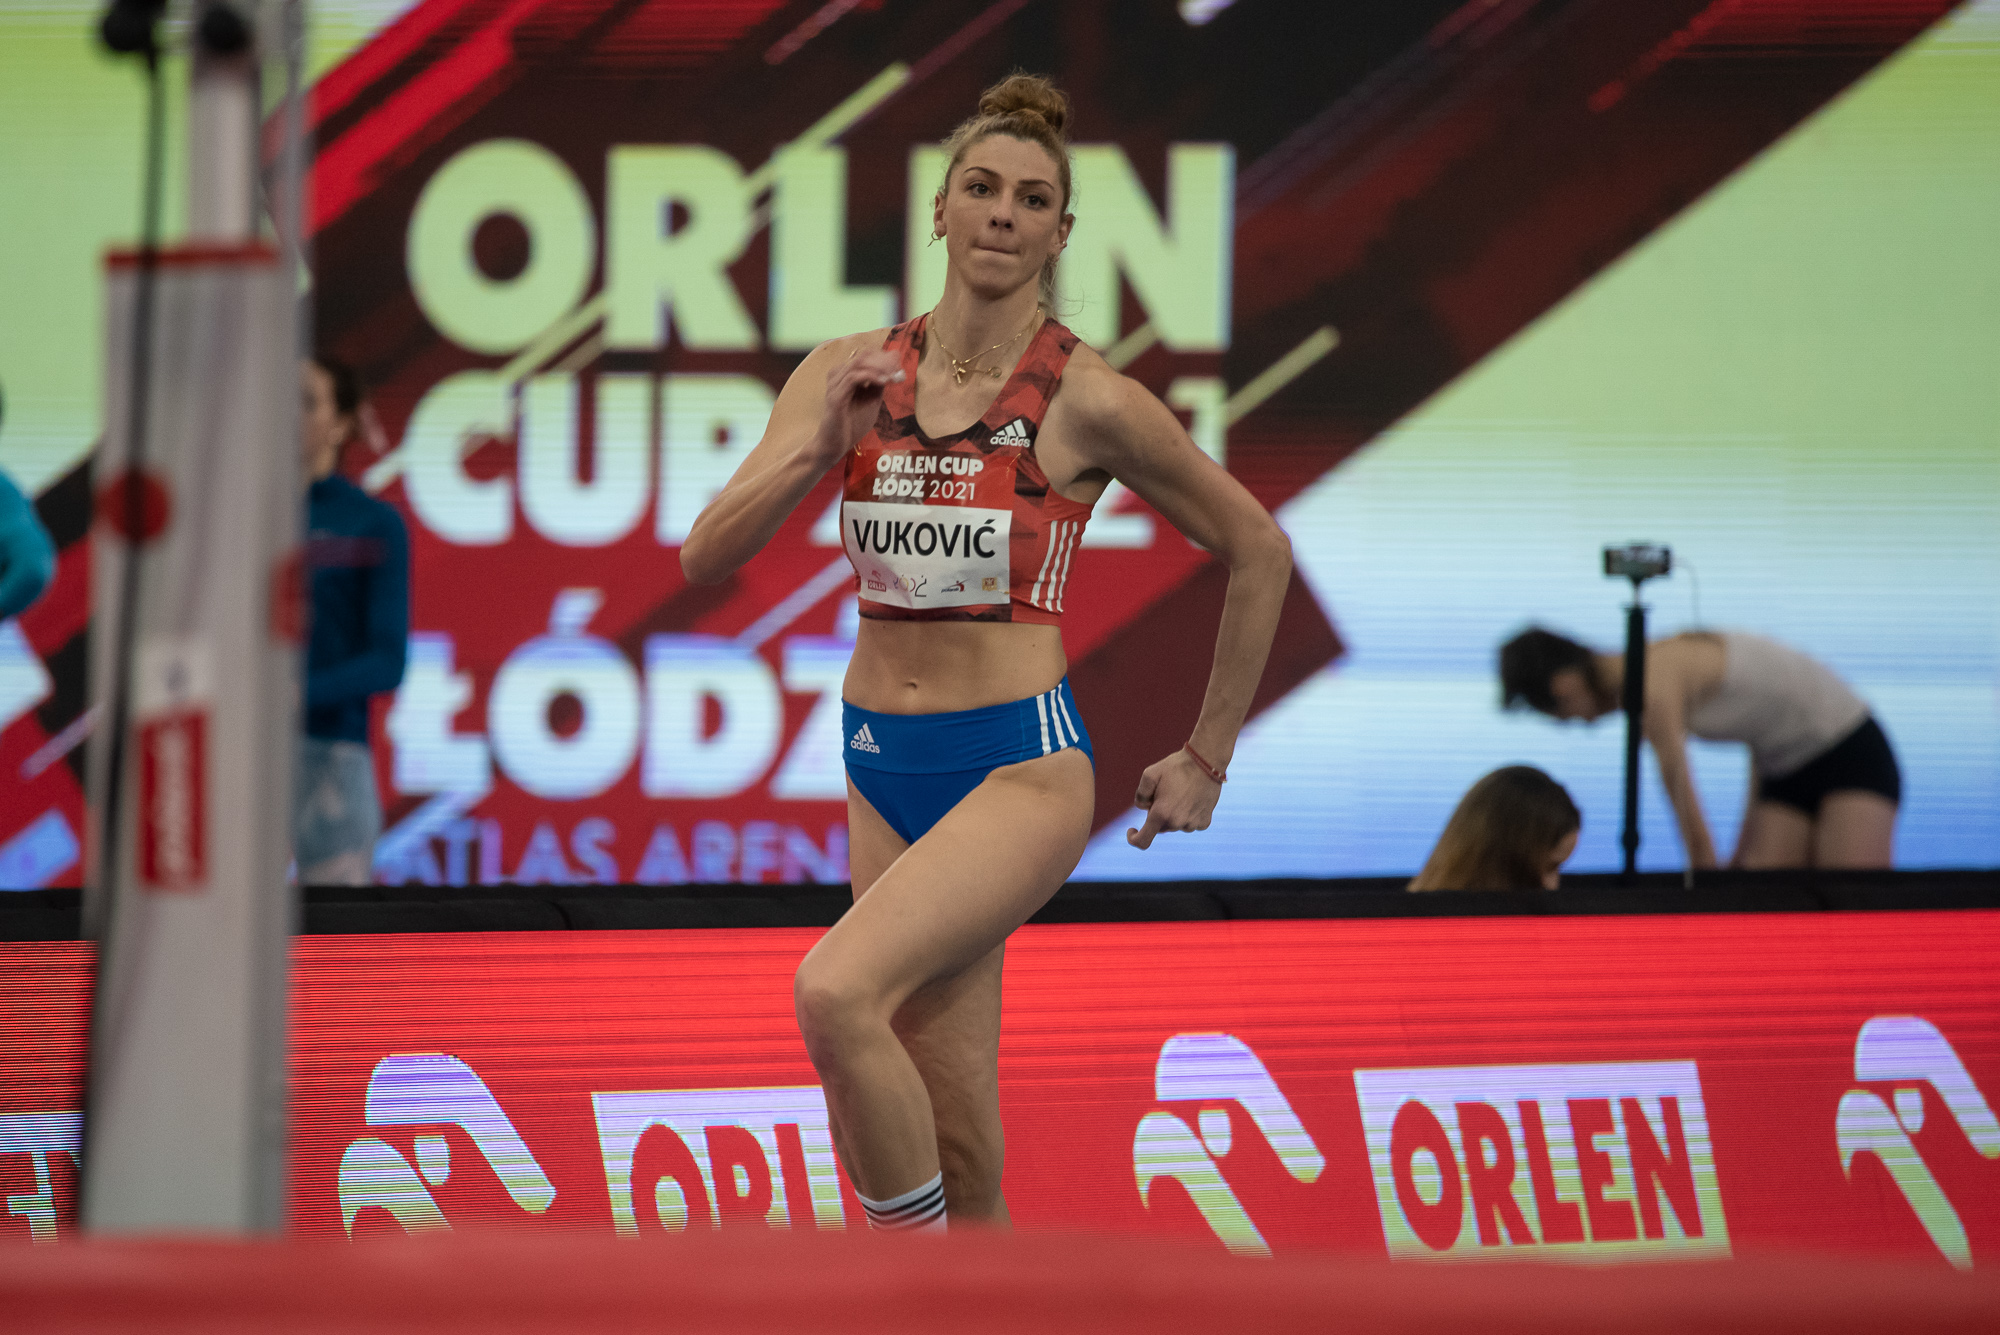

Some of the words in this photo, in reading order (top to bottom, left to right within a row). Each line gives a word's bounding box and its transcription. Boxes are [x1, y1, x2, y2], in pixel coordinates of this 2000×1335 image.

[990, 435, 1031, 448] adidas
[405, 370, 780, 547] CUP
[876, 454, 938, 474] ORLEN
[939, 456, 984, 477] CUP
[872, 474, 926, 498] ŁÓDŹ
[929, 479, 976, 501] 2021
[852, 519, 996, 559] VUKOVIĆ
[850, 739, 881, 754] adidas
[634, 818, 850, 886] AREN
[1389, 1096, 1706, 1252] ORLEN
